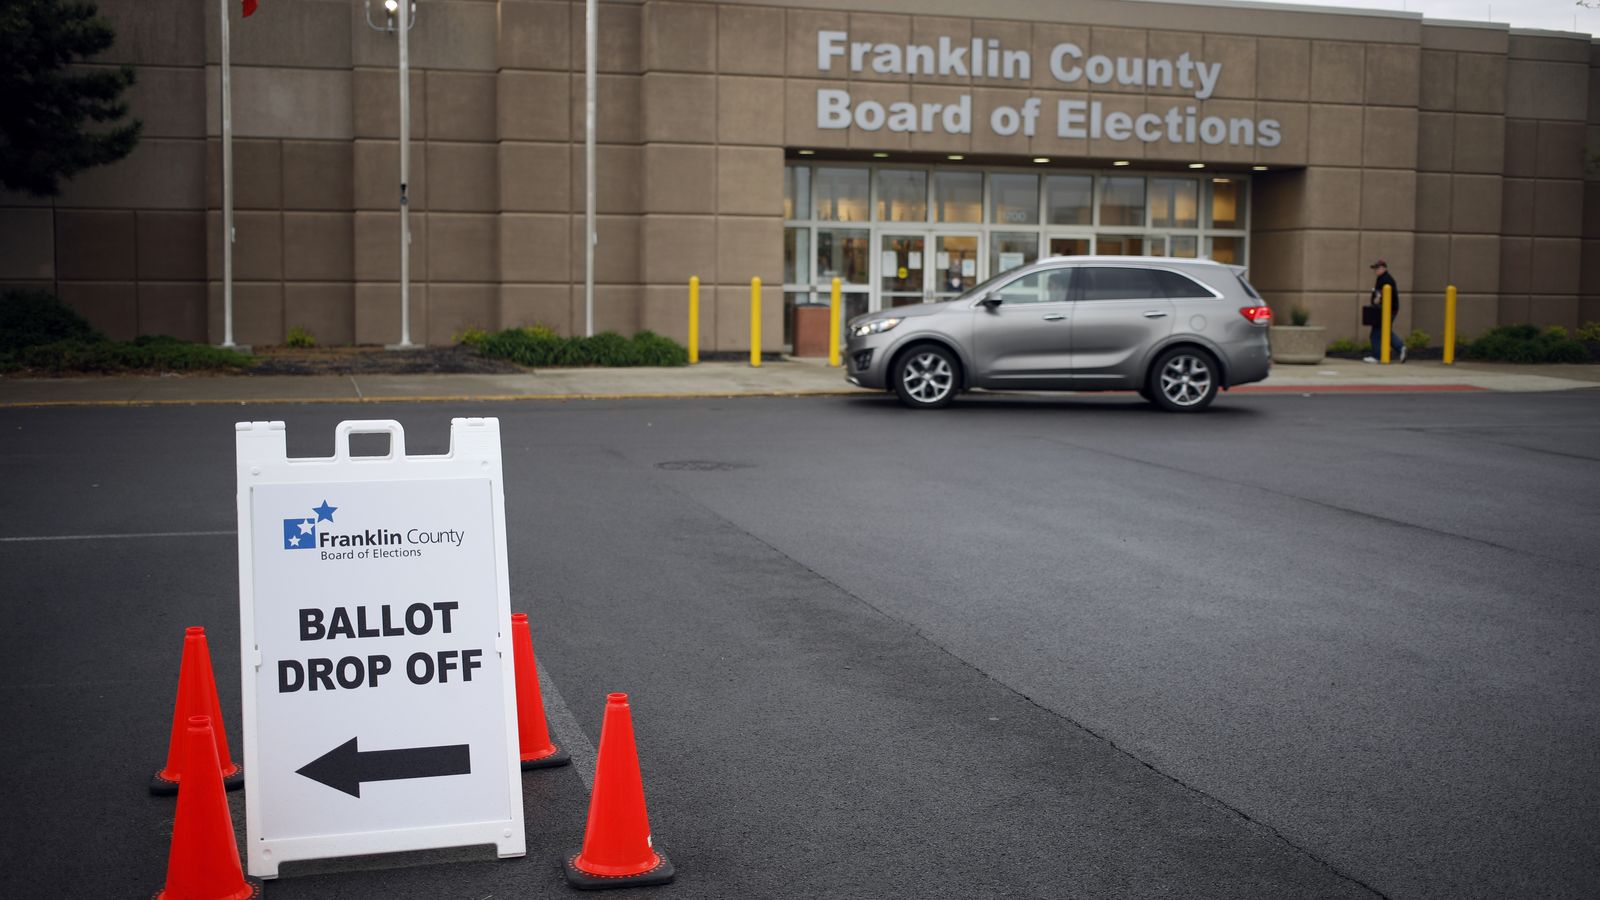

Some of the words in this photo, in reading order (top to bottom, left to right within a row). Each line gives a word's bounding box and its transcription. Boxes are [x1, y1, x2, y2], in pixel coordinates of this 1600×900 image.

[817, 29, 1031, 80] Franklin
[1050, 42, 1222, 99] County
[816, 87, 972, 134] Board
[991, 97, 1043, 136] of
[1057, 98, 1282, 147] Elections
[319, 529, 402, 548] Franklin
[406, 528, 465, 547] County
[320, 550, 354, 561] Board
[357, 549, 370, 559] of
[372, 548, 422, 559] Elections
[298, 601, 459, 642] BALLOT
[277, 655, 392, 694] DROP
[406, 648, 483, 686] OFF
